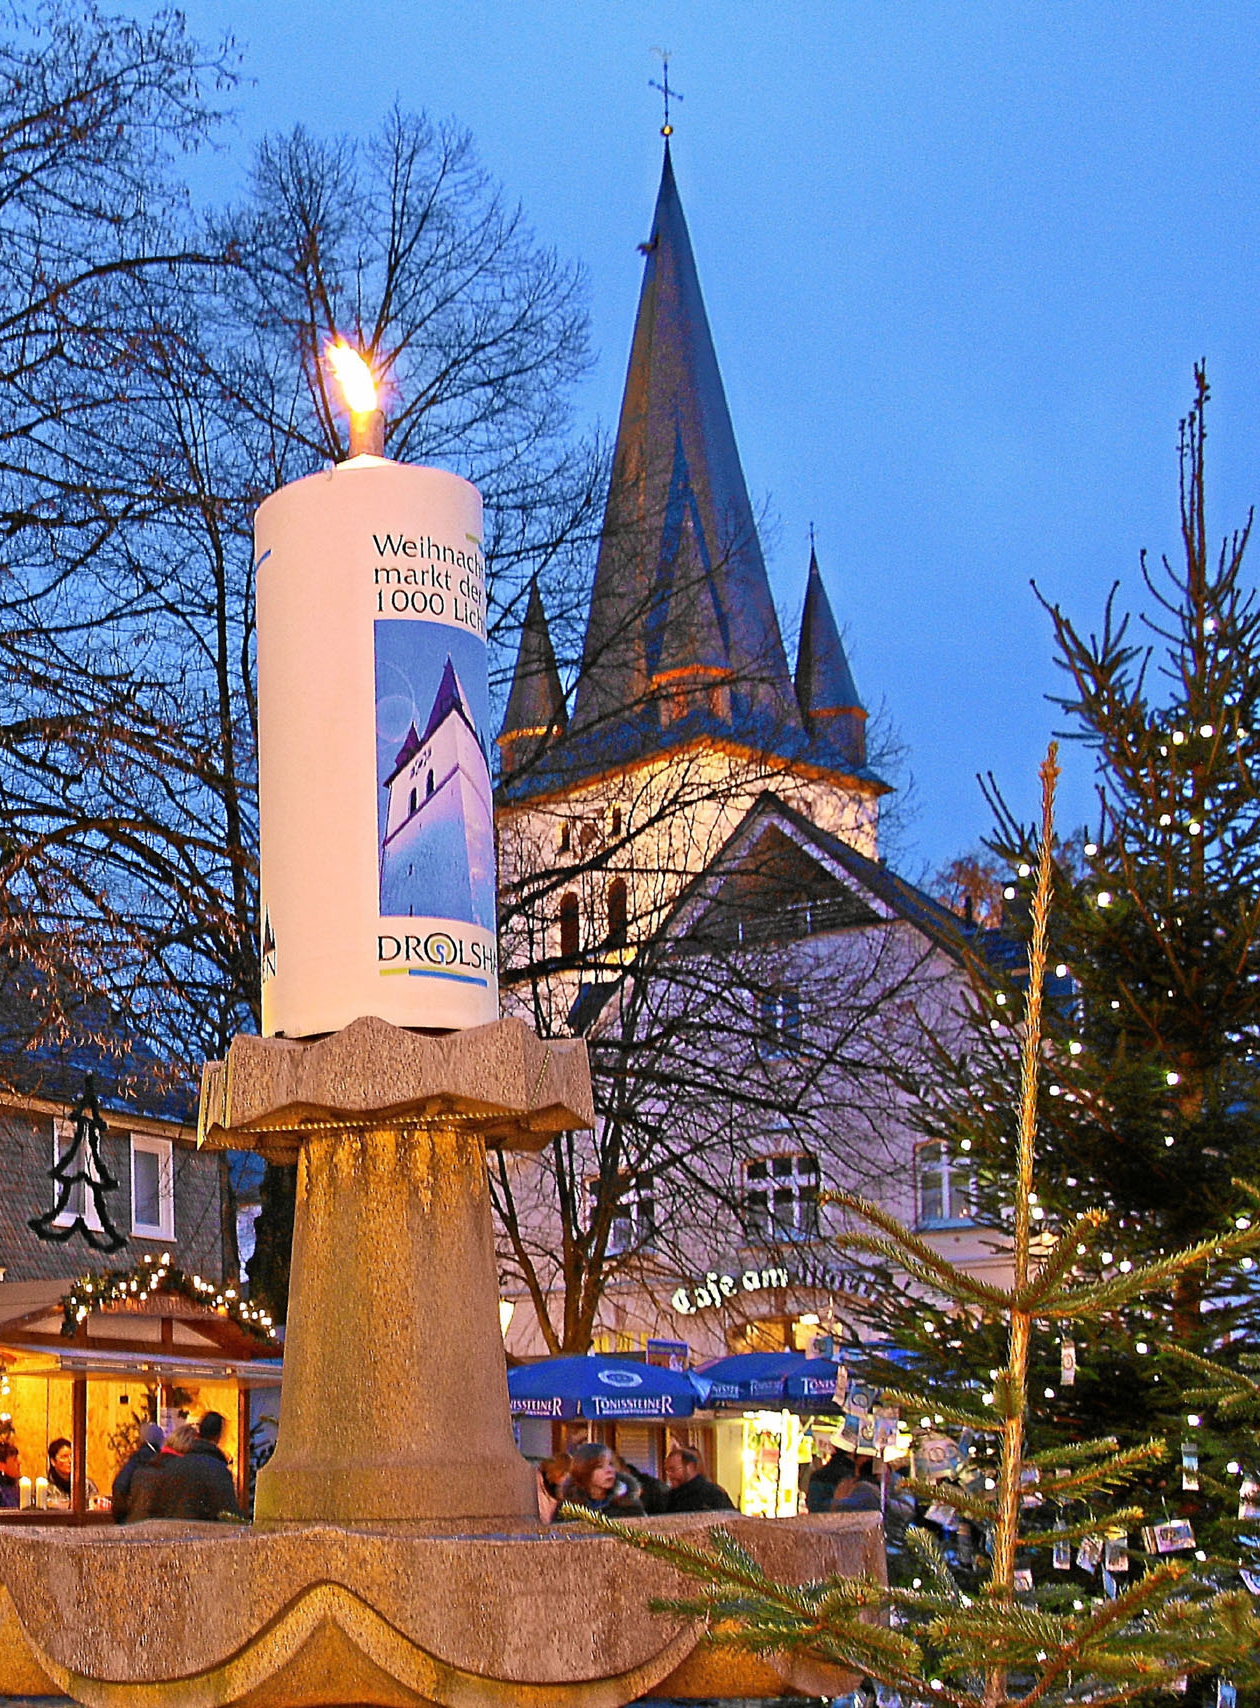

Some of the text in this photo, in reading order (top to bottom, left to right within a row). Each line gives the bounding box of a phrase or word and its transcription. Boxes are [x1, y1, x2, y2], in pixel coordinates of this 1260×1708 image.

[372, 533, 485, 583] Weihnach
[374, 563, 482, 606] markt der
[377, 588, 486, 638] 1000 Lich
